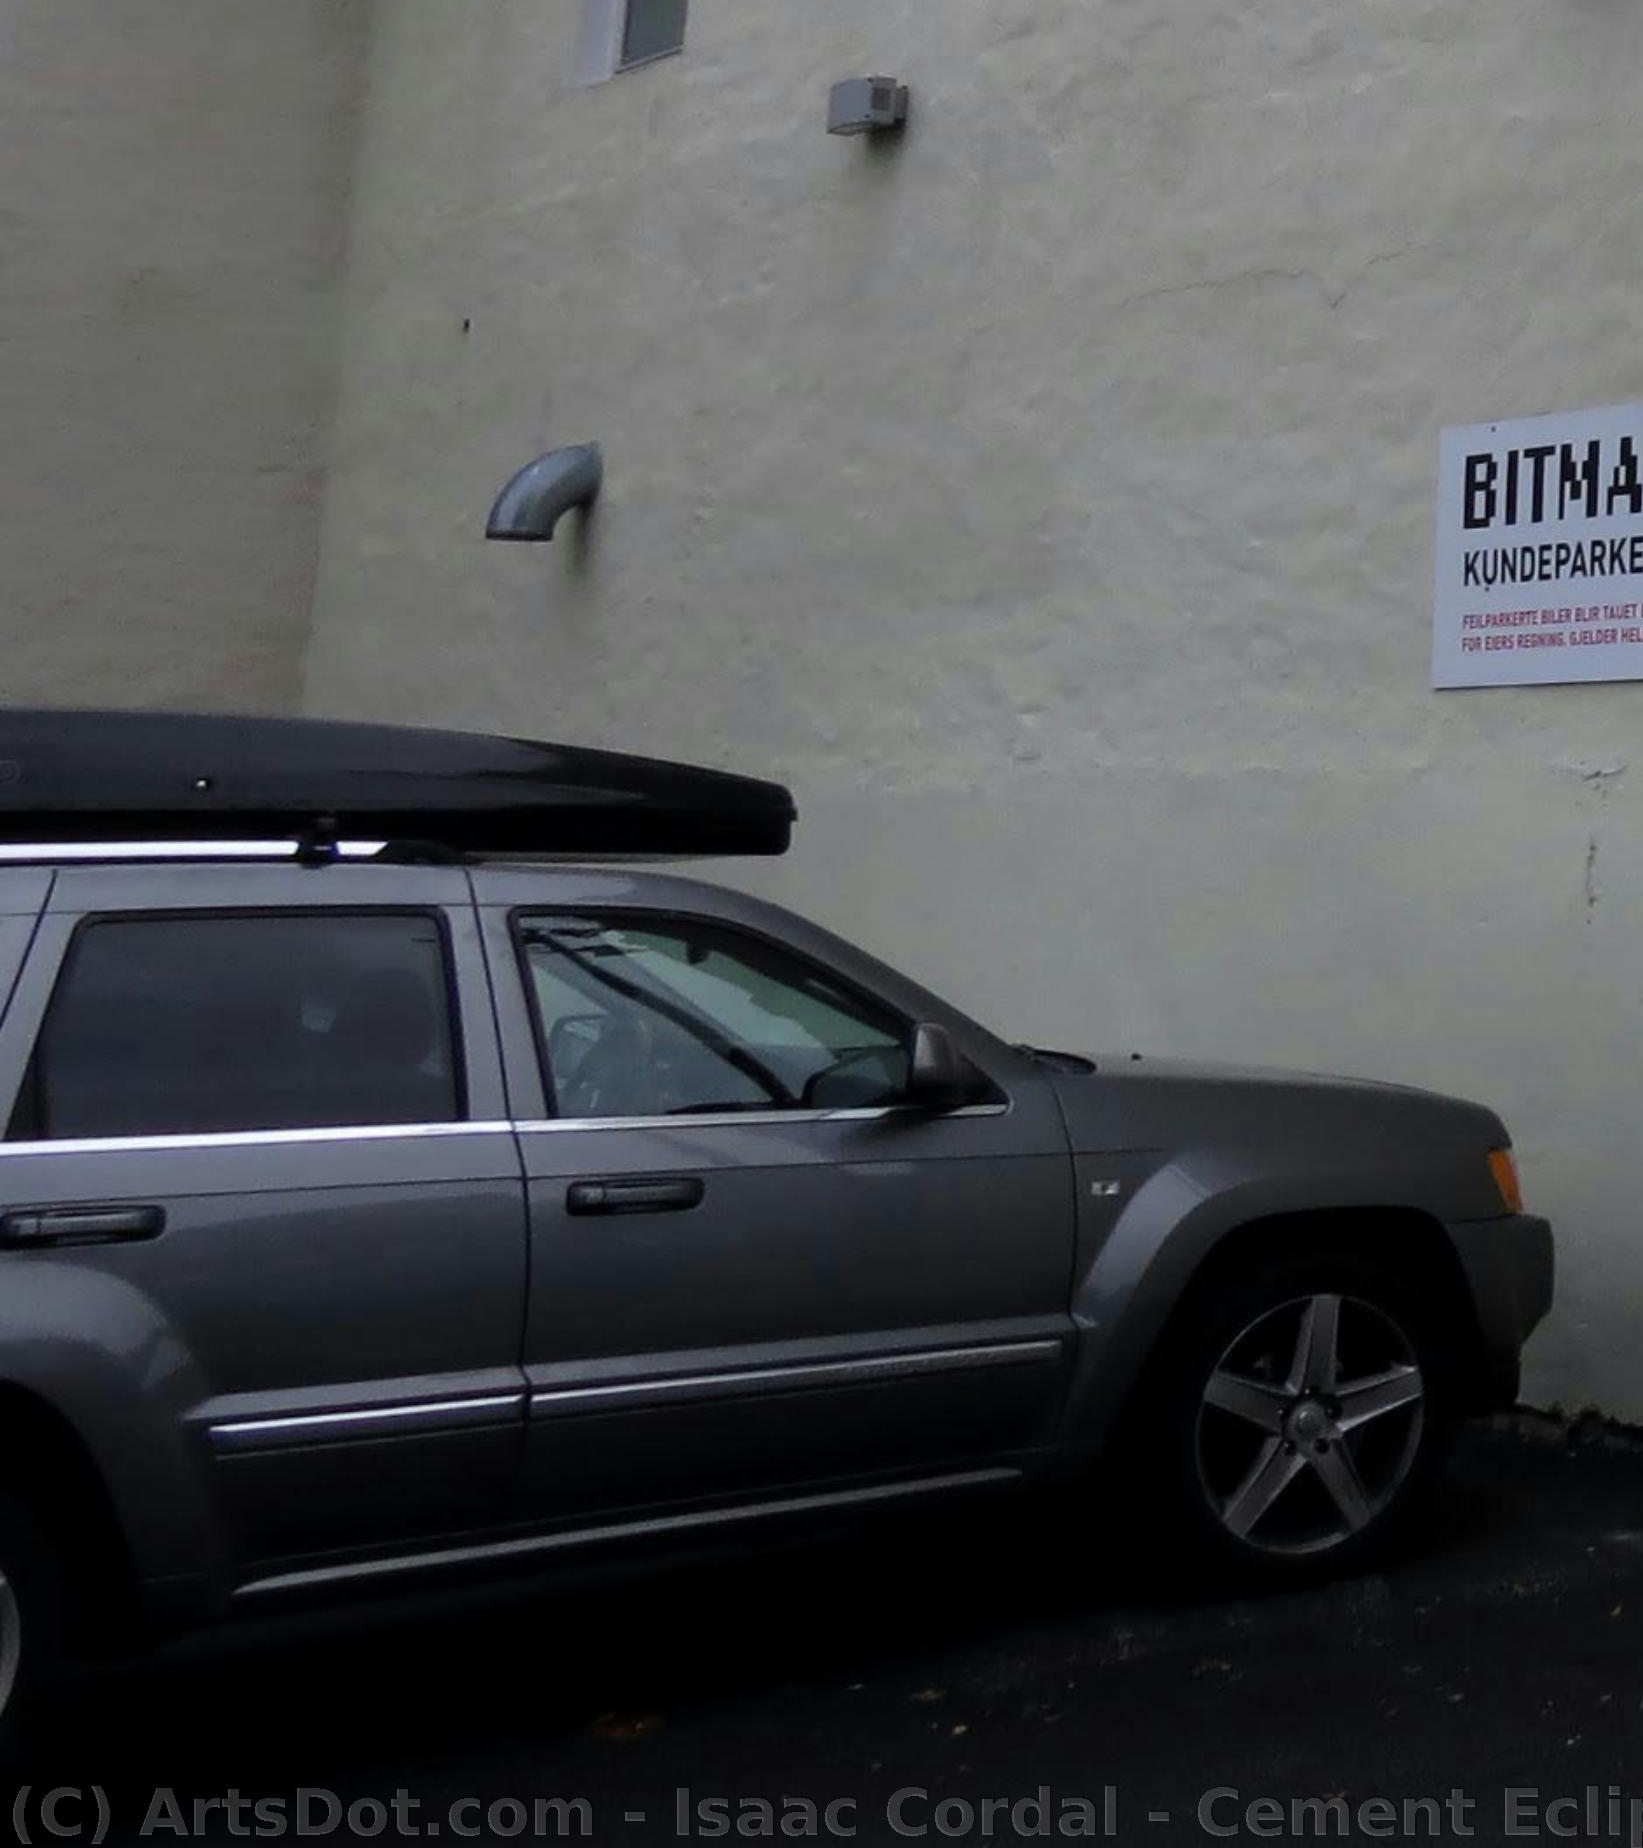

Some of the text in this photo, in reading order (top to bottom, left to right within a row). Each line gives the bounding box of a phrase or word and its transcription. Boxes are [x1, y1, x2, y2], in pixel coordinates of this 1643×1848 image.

[1462, 610, 1538, 630] FEILPARKERTE
[1541, 608, 1572, 625] BILER
[1575, 606, 1599, 623] BLIR
[1603, 603, 1638, 620] TAUET
[1462, 636, 1482, 652] FOR
[1485, 633, 1514, 650] EIERS
[1569, 627, 1618, 646] GJELDER
